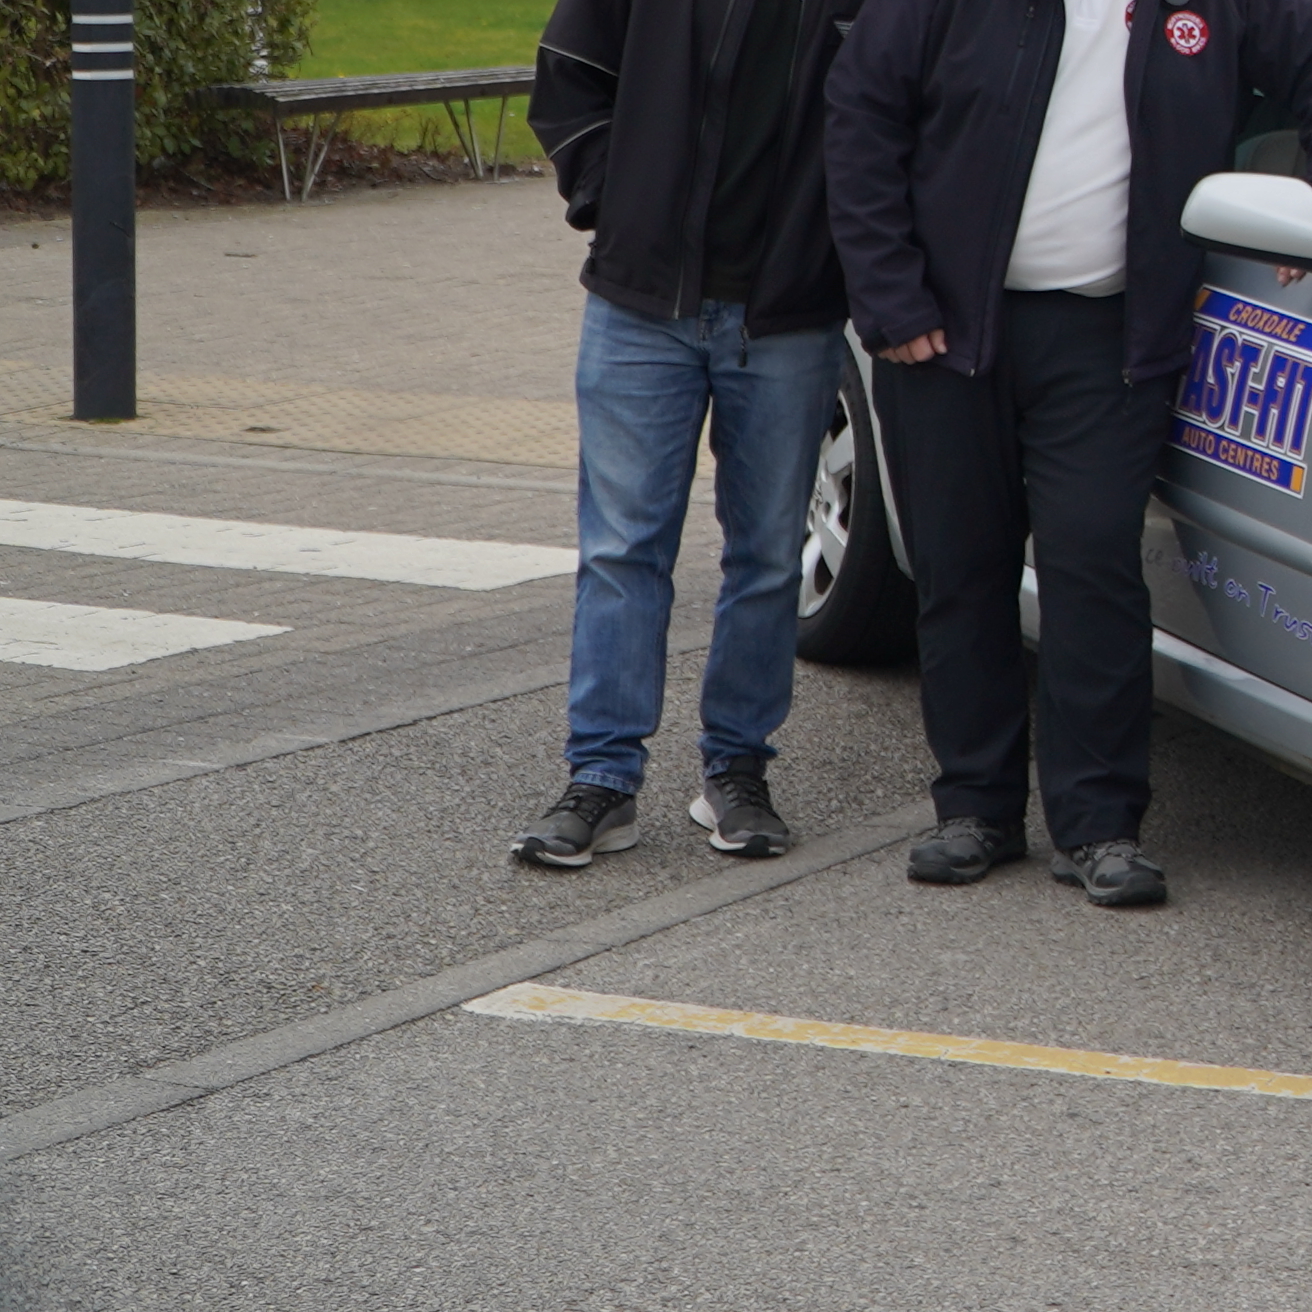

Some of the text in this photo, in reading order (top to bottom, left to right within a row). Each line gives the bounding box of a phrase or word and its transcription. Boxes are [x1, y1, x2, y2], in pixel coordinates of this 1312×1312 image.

[1229, 303, 1305, 342] CROXDALE
[1182, 427, 1280, 481] AUTO CENTRES
[1225, 578, 1250, 607] on
